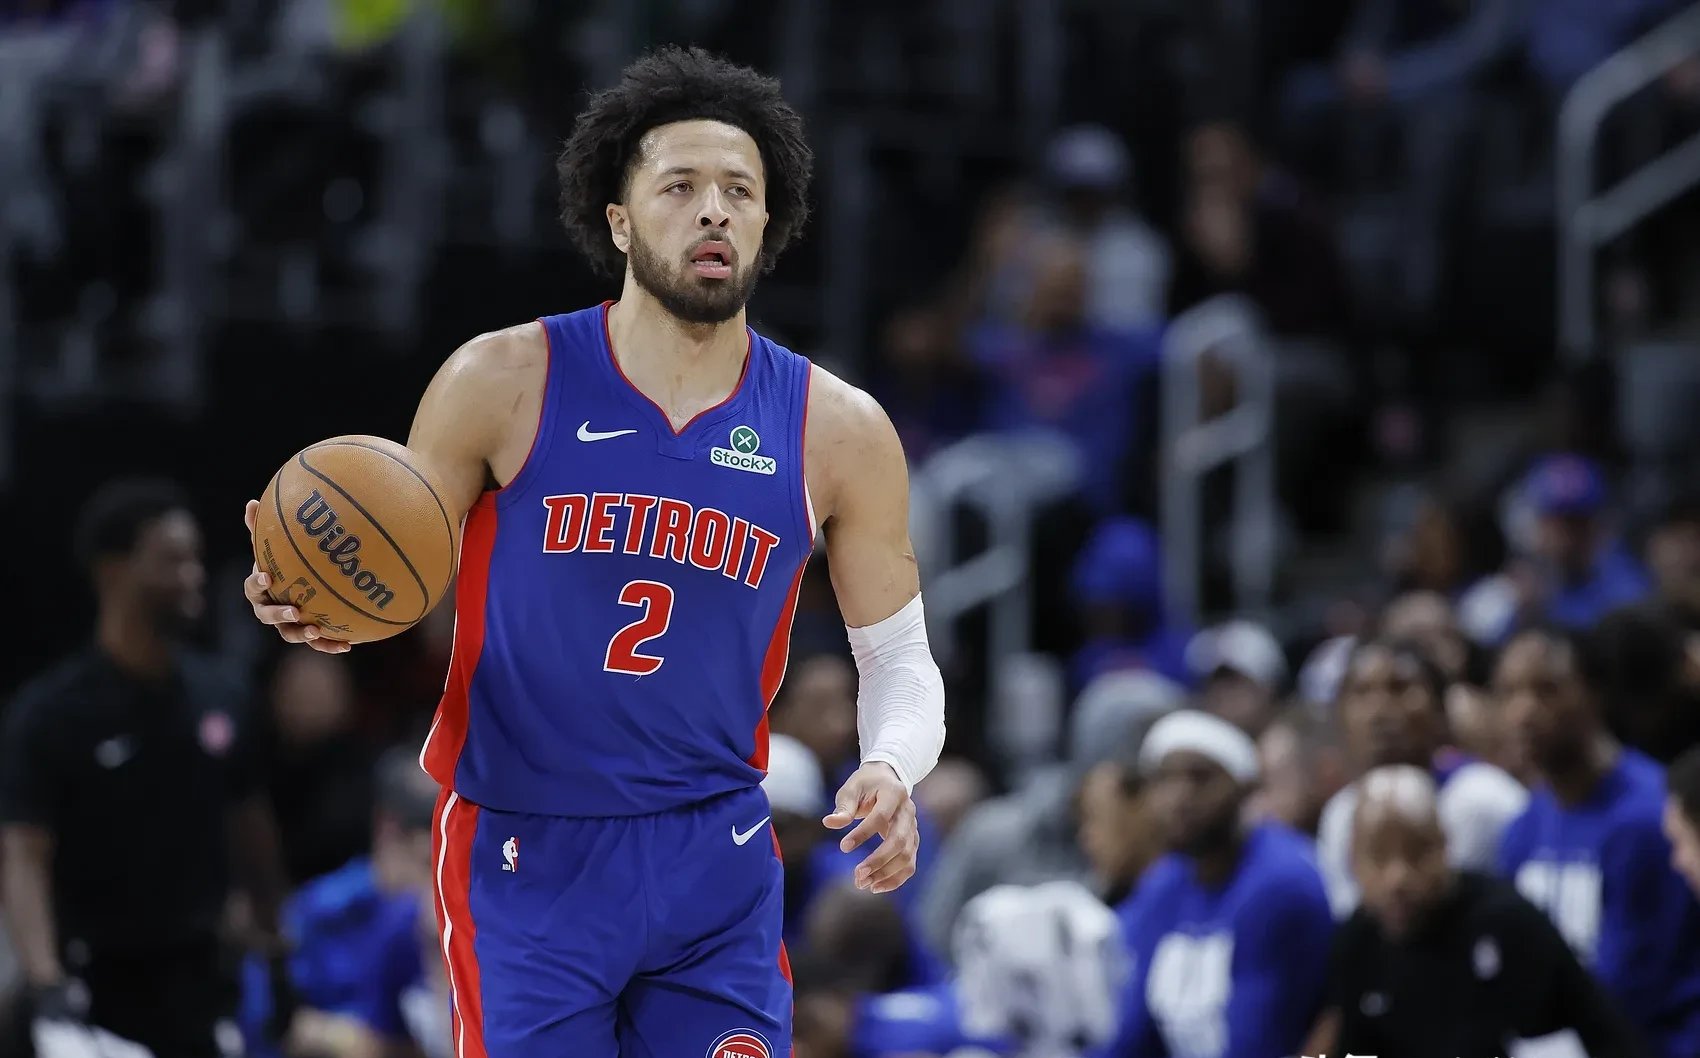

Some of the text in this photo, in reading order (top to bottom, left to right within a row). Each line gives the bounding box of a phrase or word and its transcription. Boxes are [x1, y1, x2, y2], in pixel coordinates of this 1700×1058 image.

[713, 449, 774, 472] StockX
[295, 488, 396, 611] Wilson
[543, 492, 780, 589] DETROIT
[603, 579, 674, 675] 2
